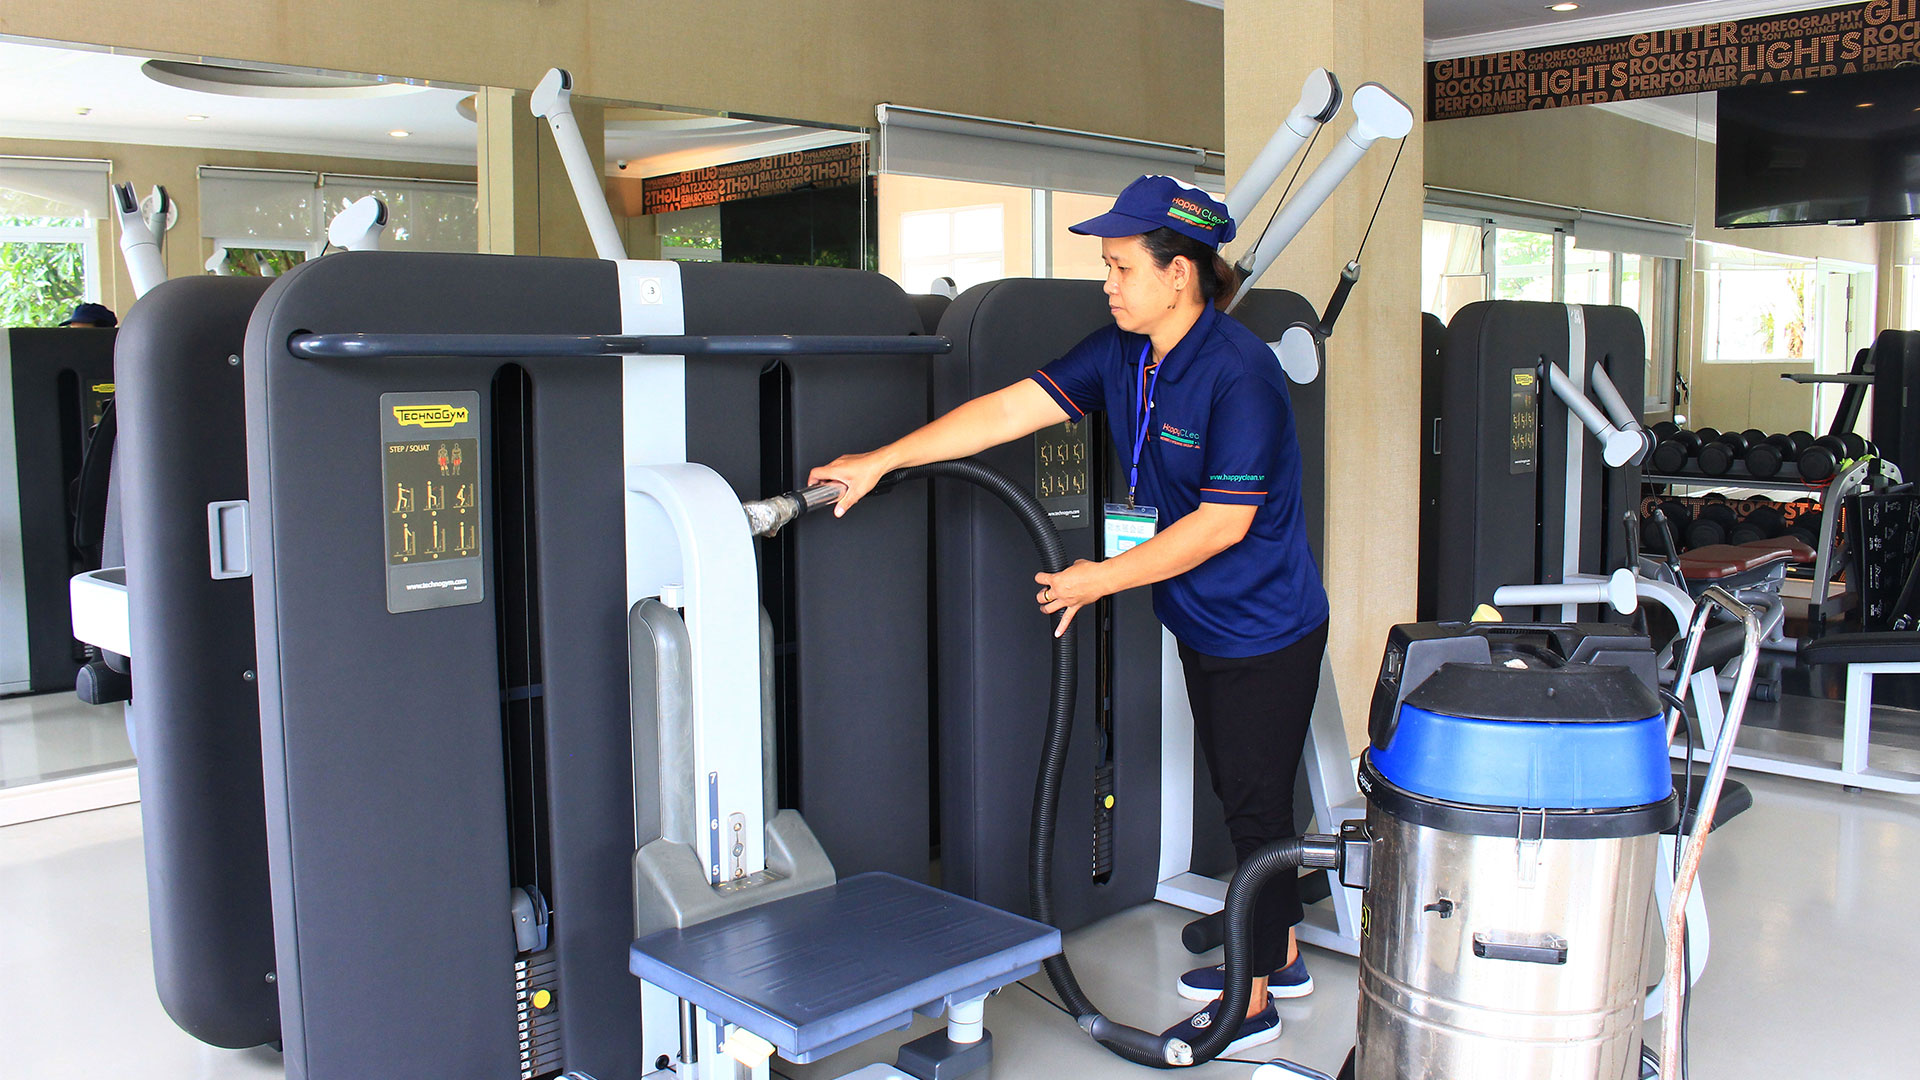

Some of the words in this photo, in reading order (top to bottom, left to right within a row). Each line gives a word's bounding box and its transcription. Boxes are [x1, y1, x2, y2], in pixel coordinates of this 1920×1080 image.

[1741, 9, 1862, 36] CHOREOGRAPHY
[1864, 0, 1920, 25] GLI
[1629, 21, 1739, 57] GLITTER
[1741, 36, 1759, 44] OUR
[1762, 32, 1781, 42] SON
[1784, 29, 1803, 38] AND
[1806, 24, 1836, 34] DANCE
[1839, 21, 1862, 30] MAN
[1528, 41, 1628, 64] CHOREOGRAPHY
[1528, 63, 1544, 71] OUR
[1546, 61, 1562, 69] SON
[1564, 58, 1580, 67] AND
[1582, 55, 1608, 65] DANCE
[1610, 53, 1629, 61] MAN
[1629, 46, 1738, 75] ROCKSTAR
[1741, 31, 1862, 72] LIGHTS
[1434, 50, 1528, 81] GLITTER
[1435, 72, 1527, 98] ROCKSTAR
[1528, 61, 1628, 97] LIGHTS
[1629, 65, 1738, 91] PERFORMER
[1629, 87, 1666, 99] GRAMMY
[1668, 84, 1700, 95] AWARD
[1703, 80, 1737, 90] WINNER
[1436, 89, 1527, 112] PERFORMER
[1468, 107, 1496, 116] AWARD
[1497, 103, 1527, 113] WINNER
[1172, 198, 1202, 215] Happy
[389, 445, 405, 453] STEP
[409, 444, 430, 452] SQUAT
[710, 772, 717, 784] 7
[711, 819, 718, 830] 6
[712, 865, 719, 876] 5
